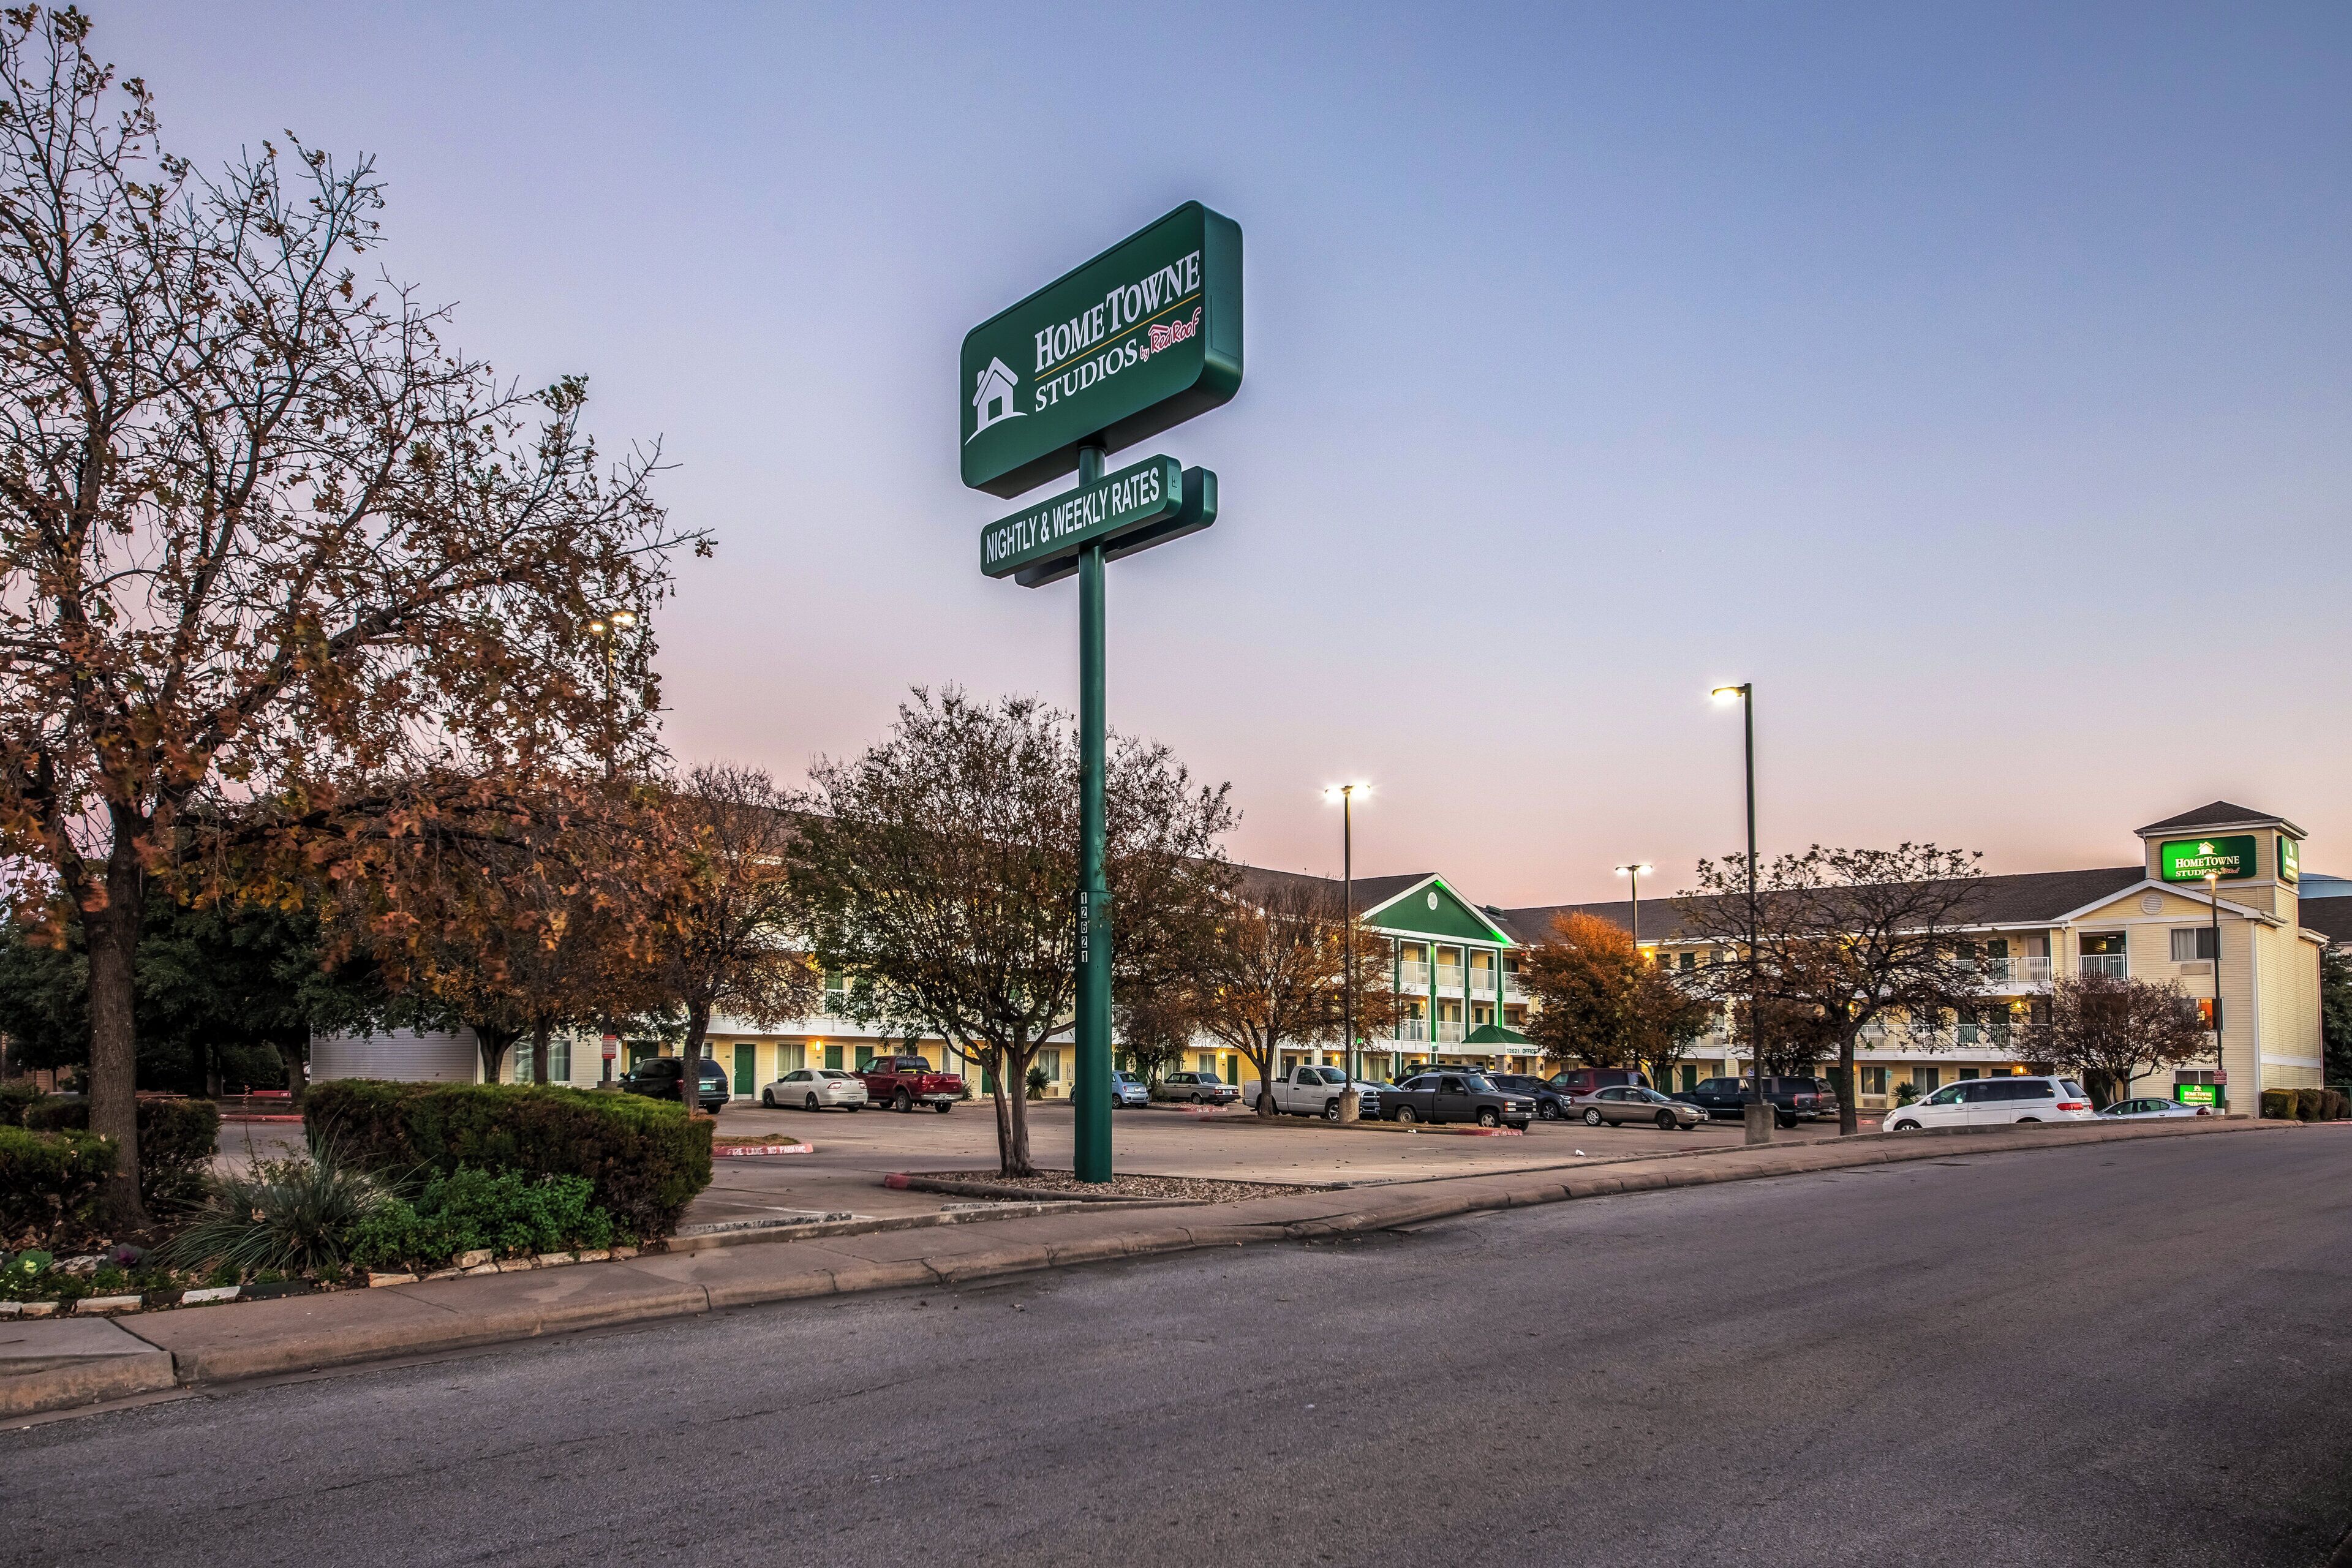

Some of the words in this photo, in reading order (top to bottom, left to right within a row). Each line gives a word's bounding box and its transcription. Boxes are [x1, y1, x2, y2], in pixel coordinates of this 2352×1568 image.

[1035, 338, 1137, 412] STUDIOS
[1140, 345, 1149, 362] by
[987, 516, 1038, 564] NIGHTLY
[1041, 511, 1050, 543] &
[1053, 486, 1109, 538] WEEKLY
[1112, 467, 1159, 516] RATES
[779, 1145, 806, 1154] PARKING
